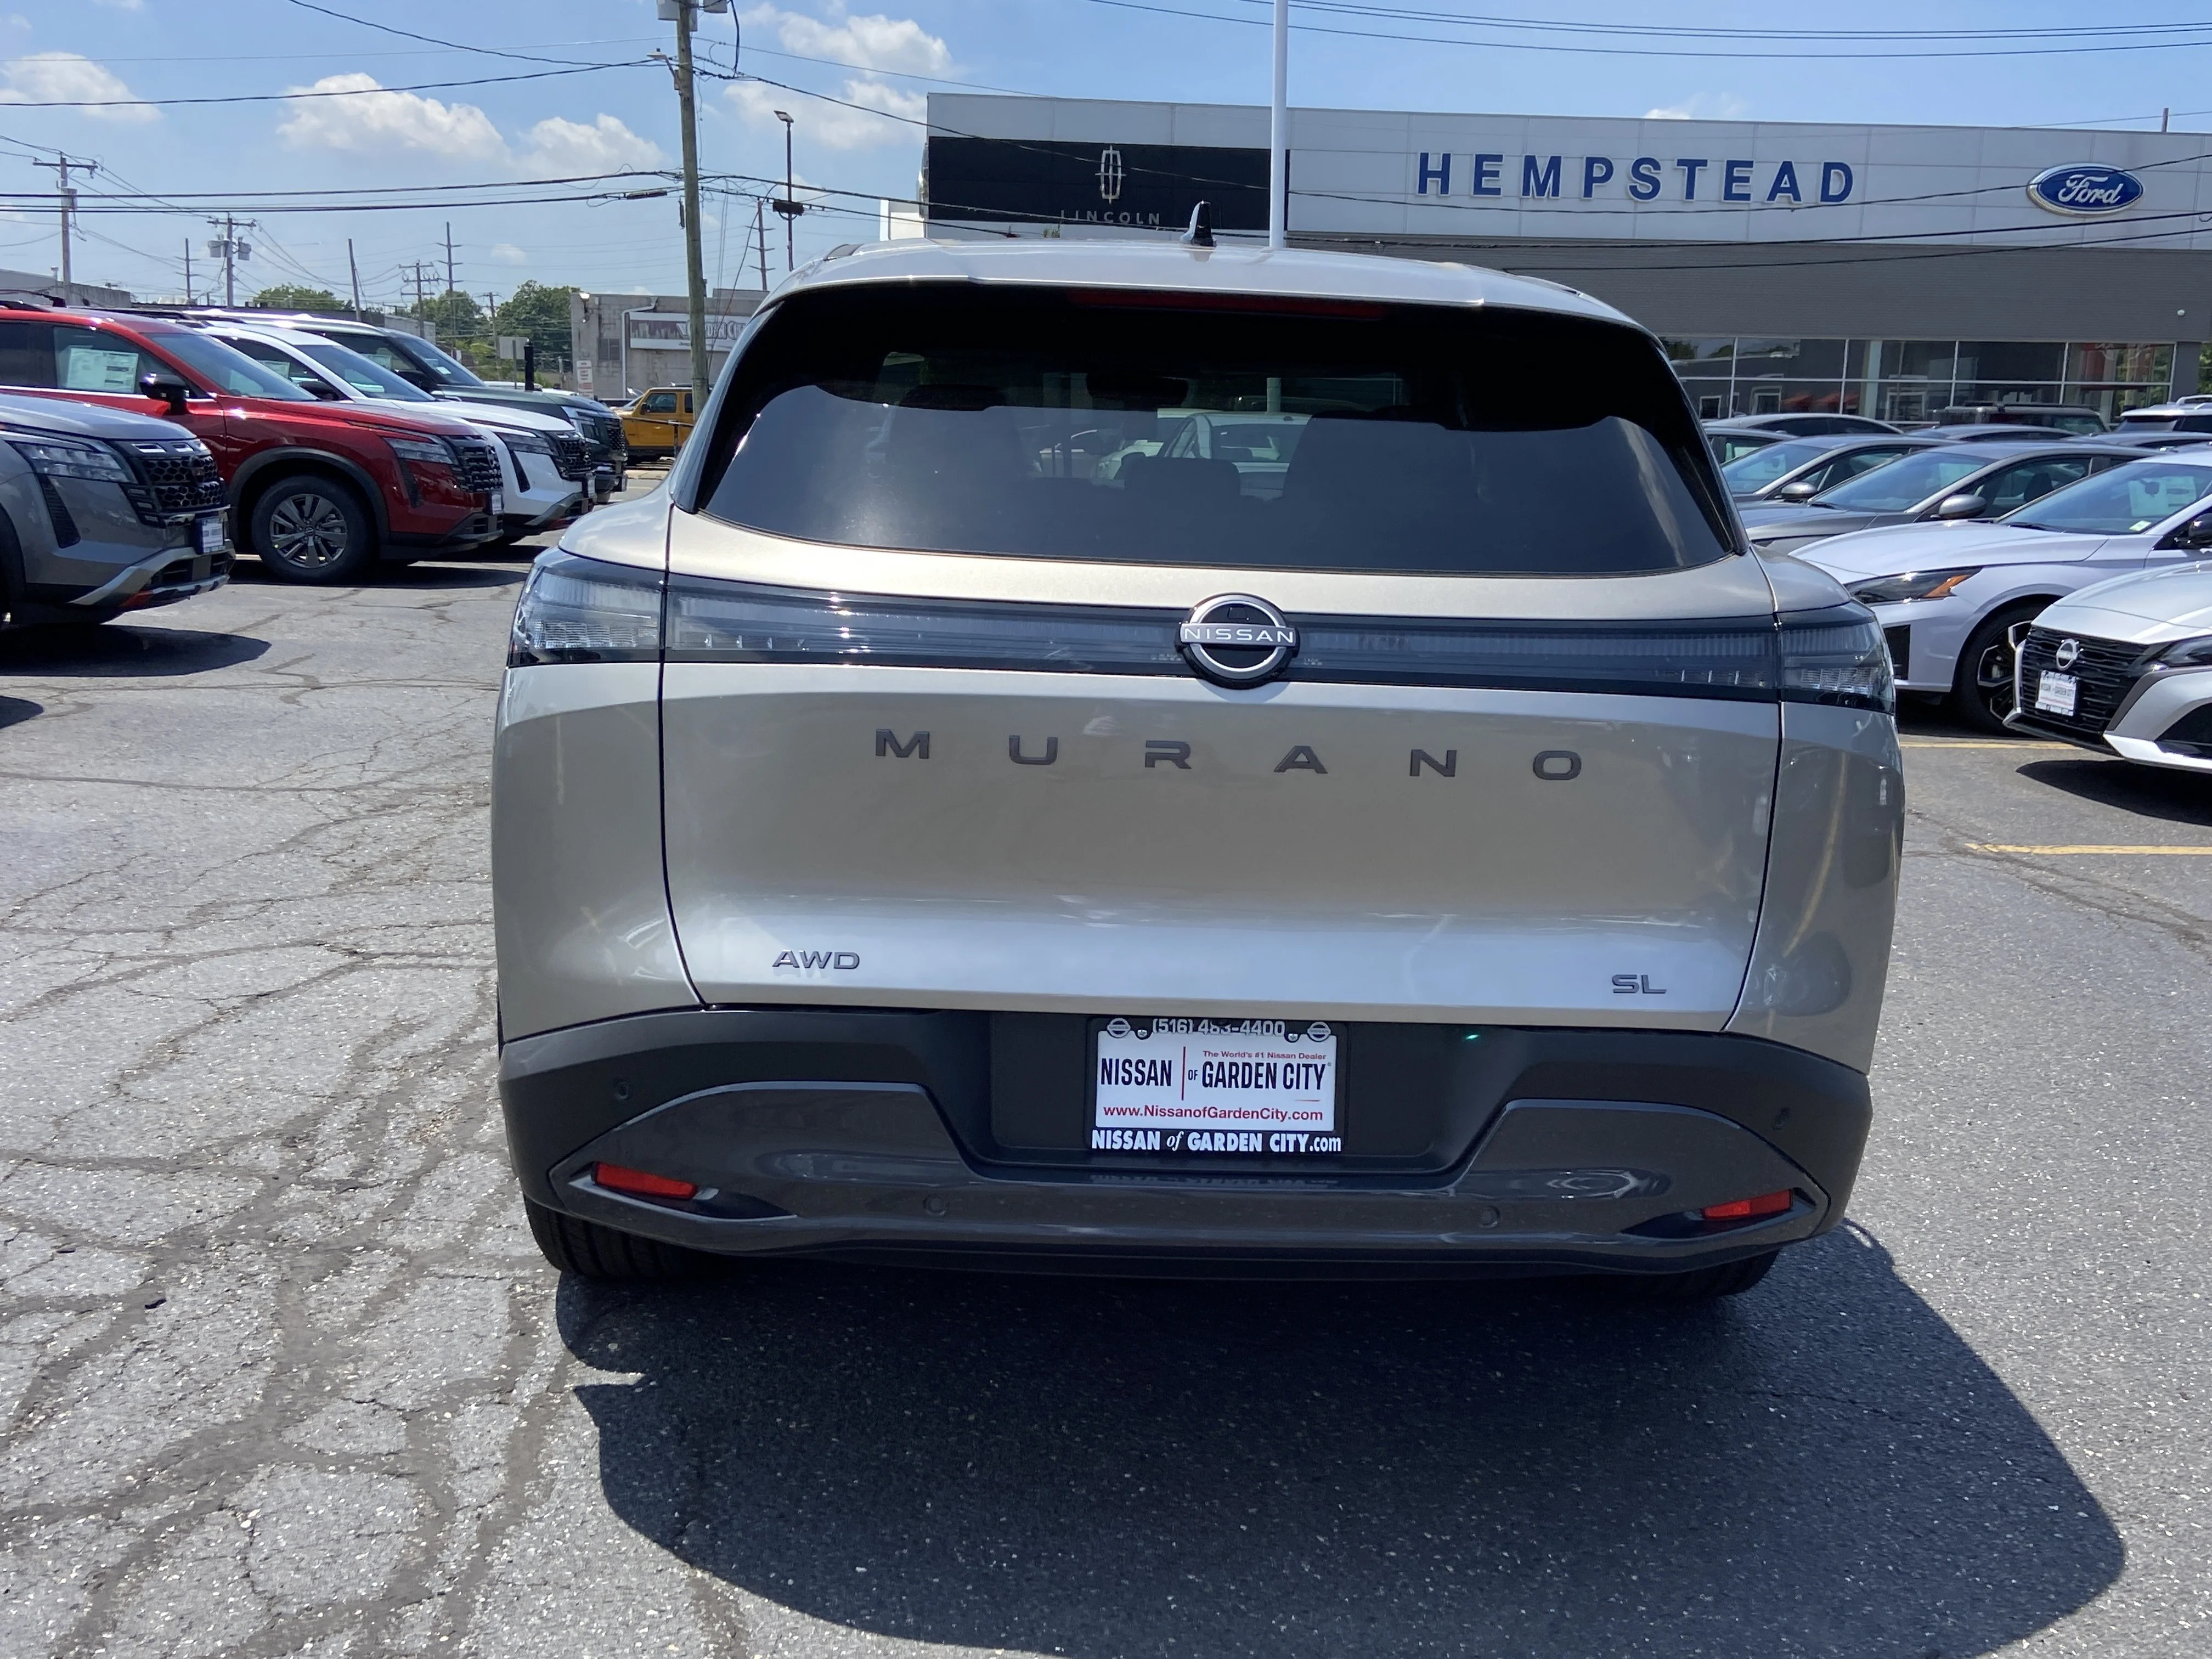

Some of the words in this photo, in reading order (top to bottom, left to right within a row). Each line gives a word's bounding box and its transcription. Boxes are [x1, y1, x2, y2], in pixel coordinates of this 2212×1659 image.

[1417, 151, 1854, 204] HEMPSTEAD
[2058, 174, 2124, 204] Ford
[1060, 210, 1160, 225] LINCOLN
[1184, 628, 1294, 644] NISSAN
[875, 728, 1582, 781] MURANO
[772, 949, 860, 970] AWD
[1612, 974, 1667, 994] SL
[1152, 1018, 1193, 1034] (516)
[1101, 1058, 1172, 1087] NISSAN
[1188, 1069, 1198, 1081] OF
[1201, 1061, 1277, 1089] GARDEN
[1283, 1063, 1326, 1090] CITY
[1103, 1105, 1323, 1123] www.NissanofGardenCity.com
[1091, 1129, 1161, 1150] NISSAN
[1166, 1131, 1185, 1150] of
[1187, 1131, 1263, 1152] GARDEN
[1269, 1133, 1342, 1153] CITY.com
